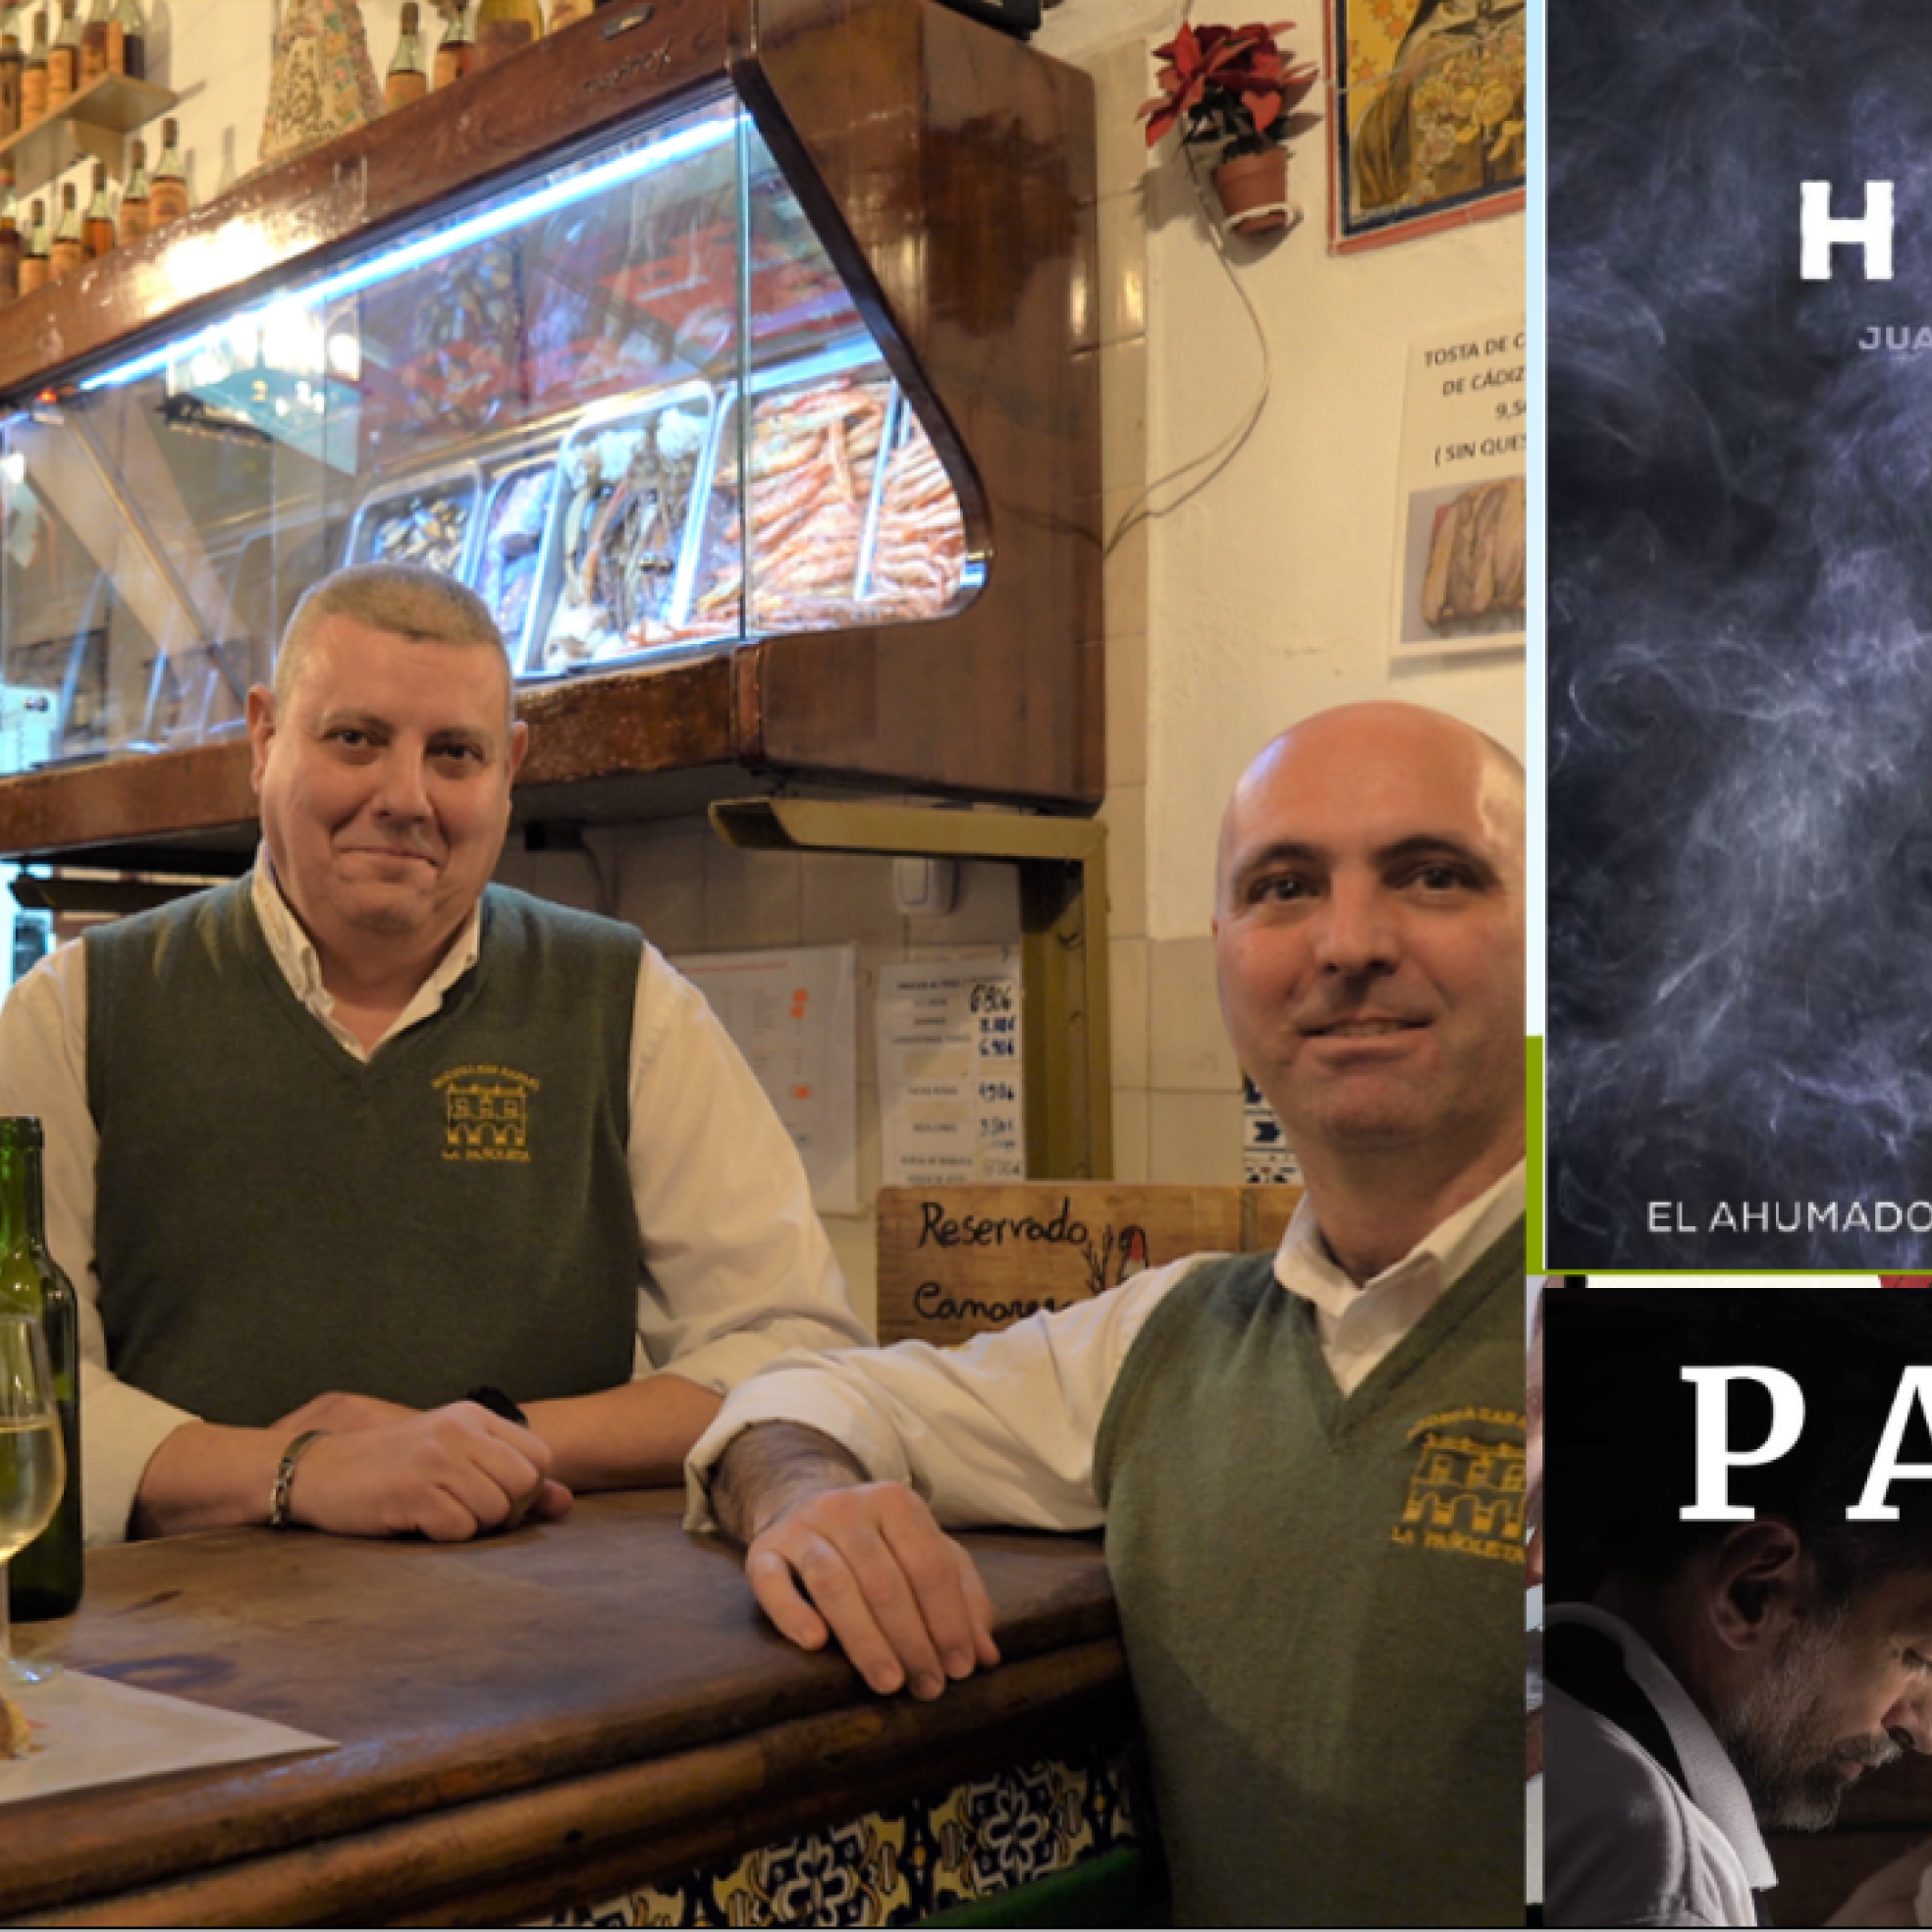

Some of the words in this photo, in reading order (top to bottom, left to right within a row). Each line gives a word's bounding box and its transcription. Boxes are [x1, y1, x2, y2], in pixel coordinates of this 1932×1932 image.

[1800, 180, 1894, 280] H
[1424, 344, 1479, 367] TOSTA
[1484, 336, 1509, 356] DE
[1858, 326, 1932, 349] JUA
[1442, 376, 1466, 397] DE
[1445, 440, 1476, 462] SIN
[918, 1196, 1089, 1249] Reservado
[1647, 1201, 1697, 1233] EL
[1708, 1201, 1932, 1233] AHUMADO
[1679, 1365, 1932, 1523] PA
